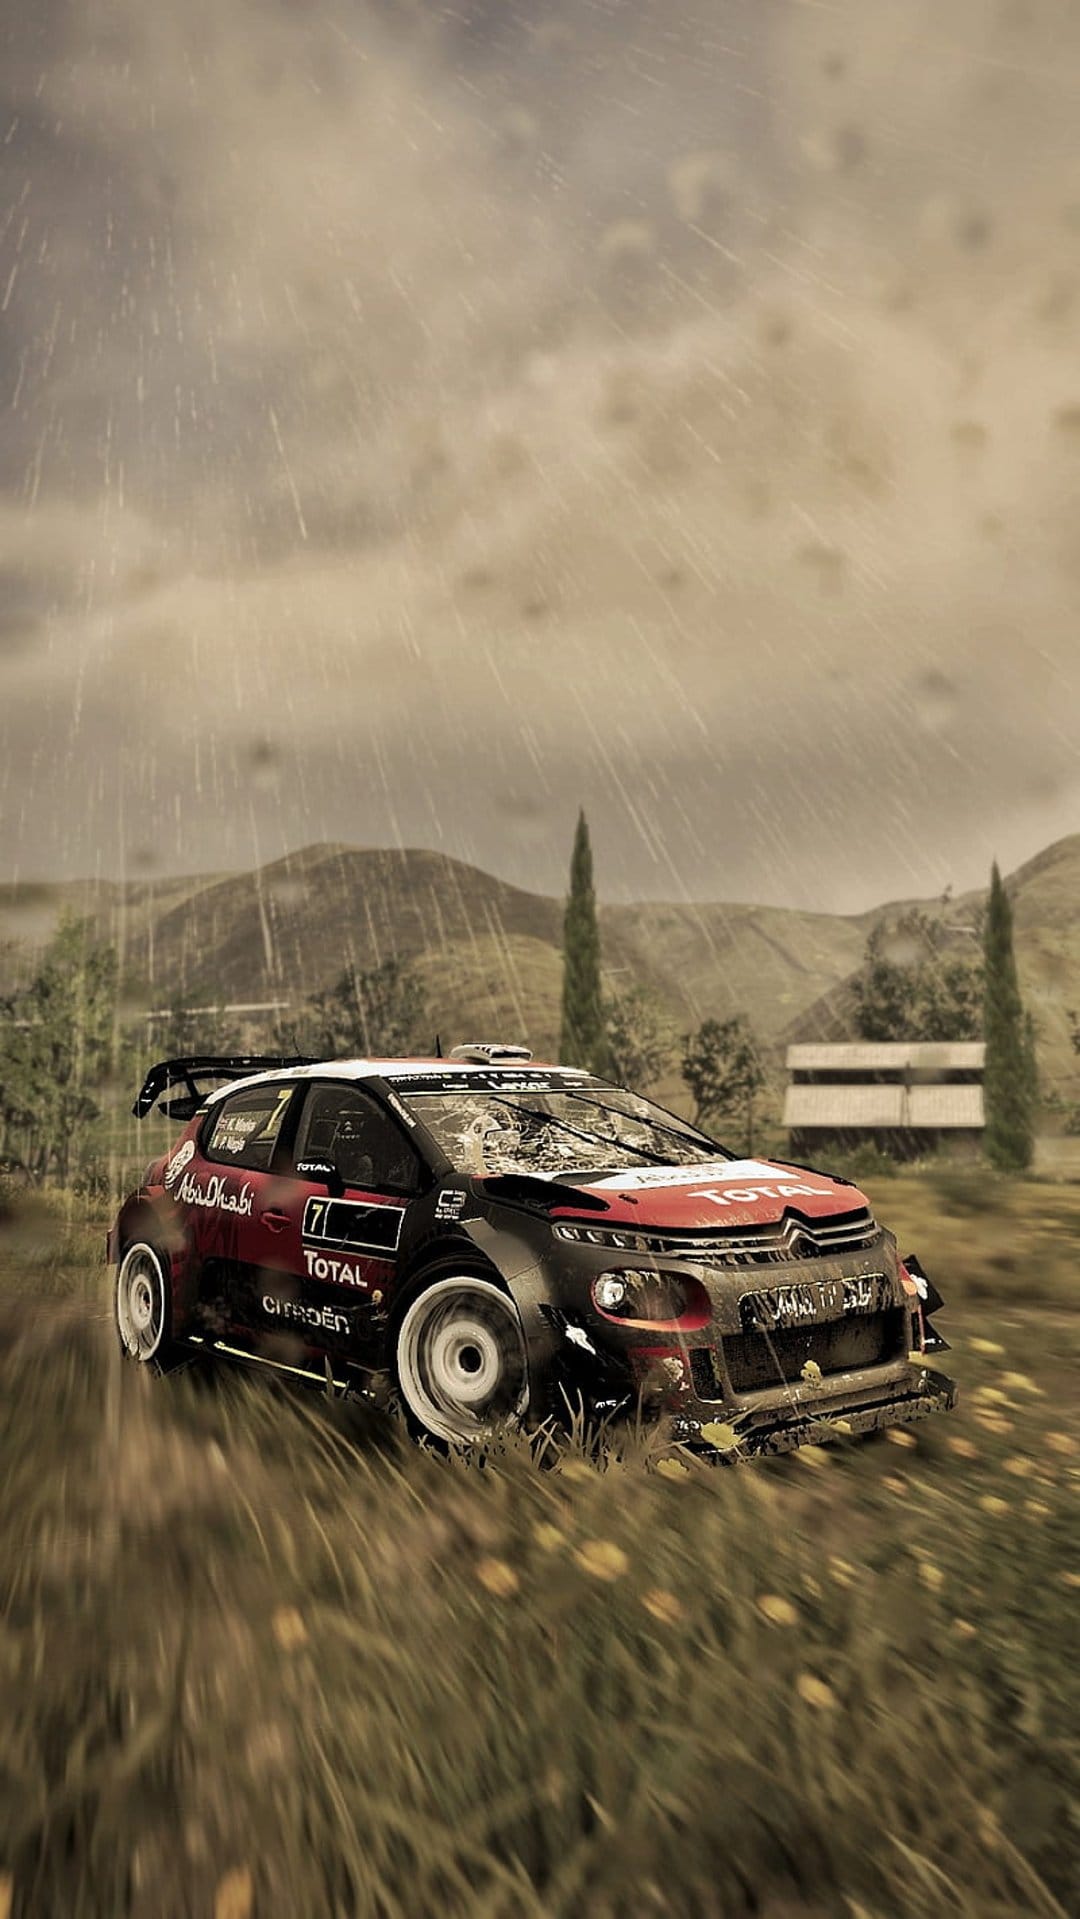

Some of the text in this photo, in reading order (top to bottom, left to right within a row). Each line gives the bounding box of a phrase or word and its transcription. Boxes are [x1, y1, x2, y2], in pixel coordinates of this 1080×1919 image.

[267, 1089, 293, 1131] 7
[297, 1163, 331, 1172] TOTAL
[687, 1184, 835, 1206] TOTAL
[311, 1203, 324, 1232] 7
[303, 1250, 368, 1288] TOTAL
